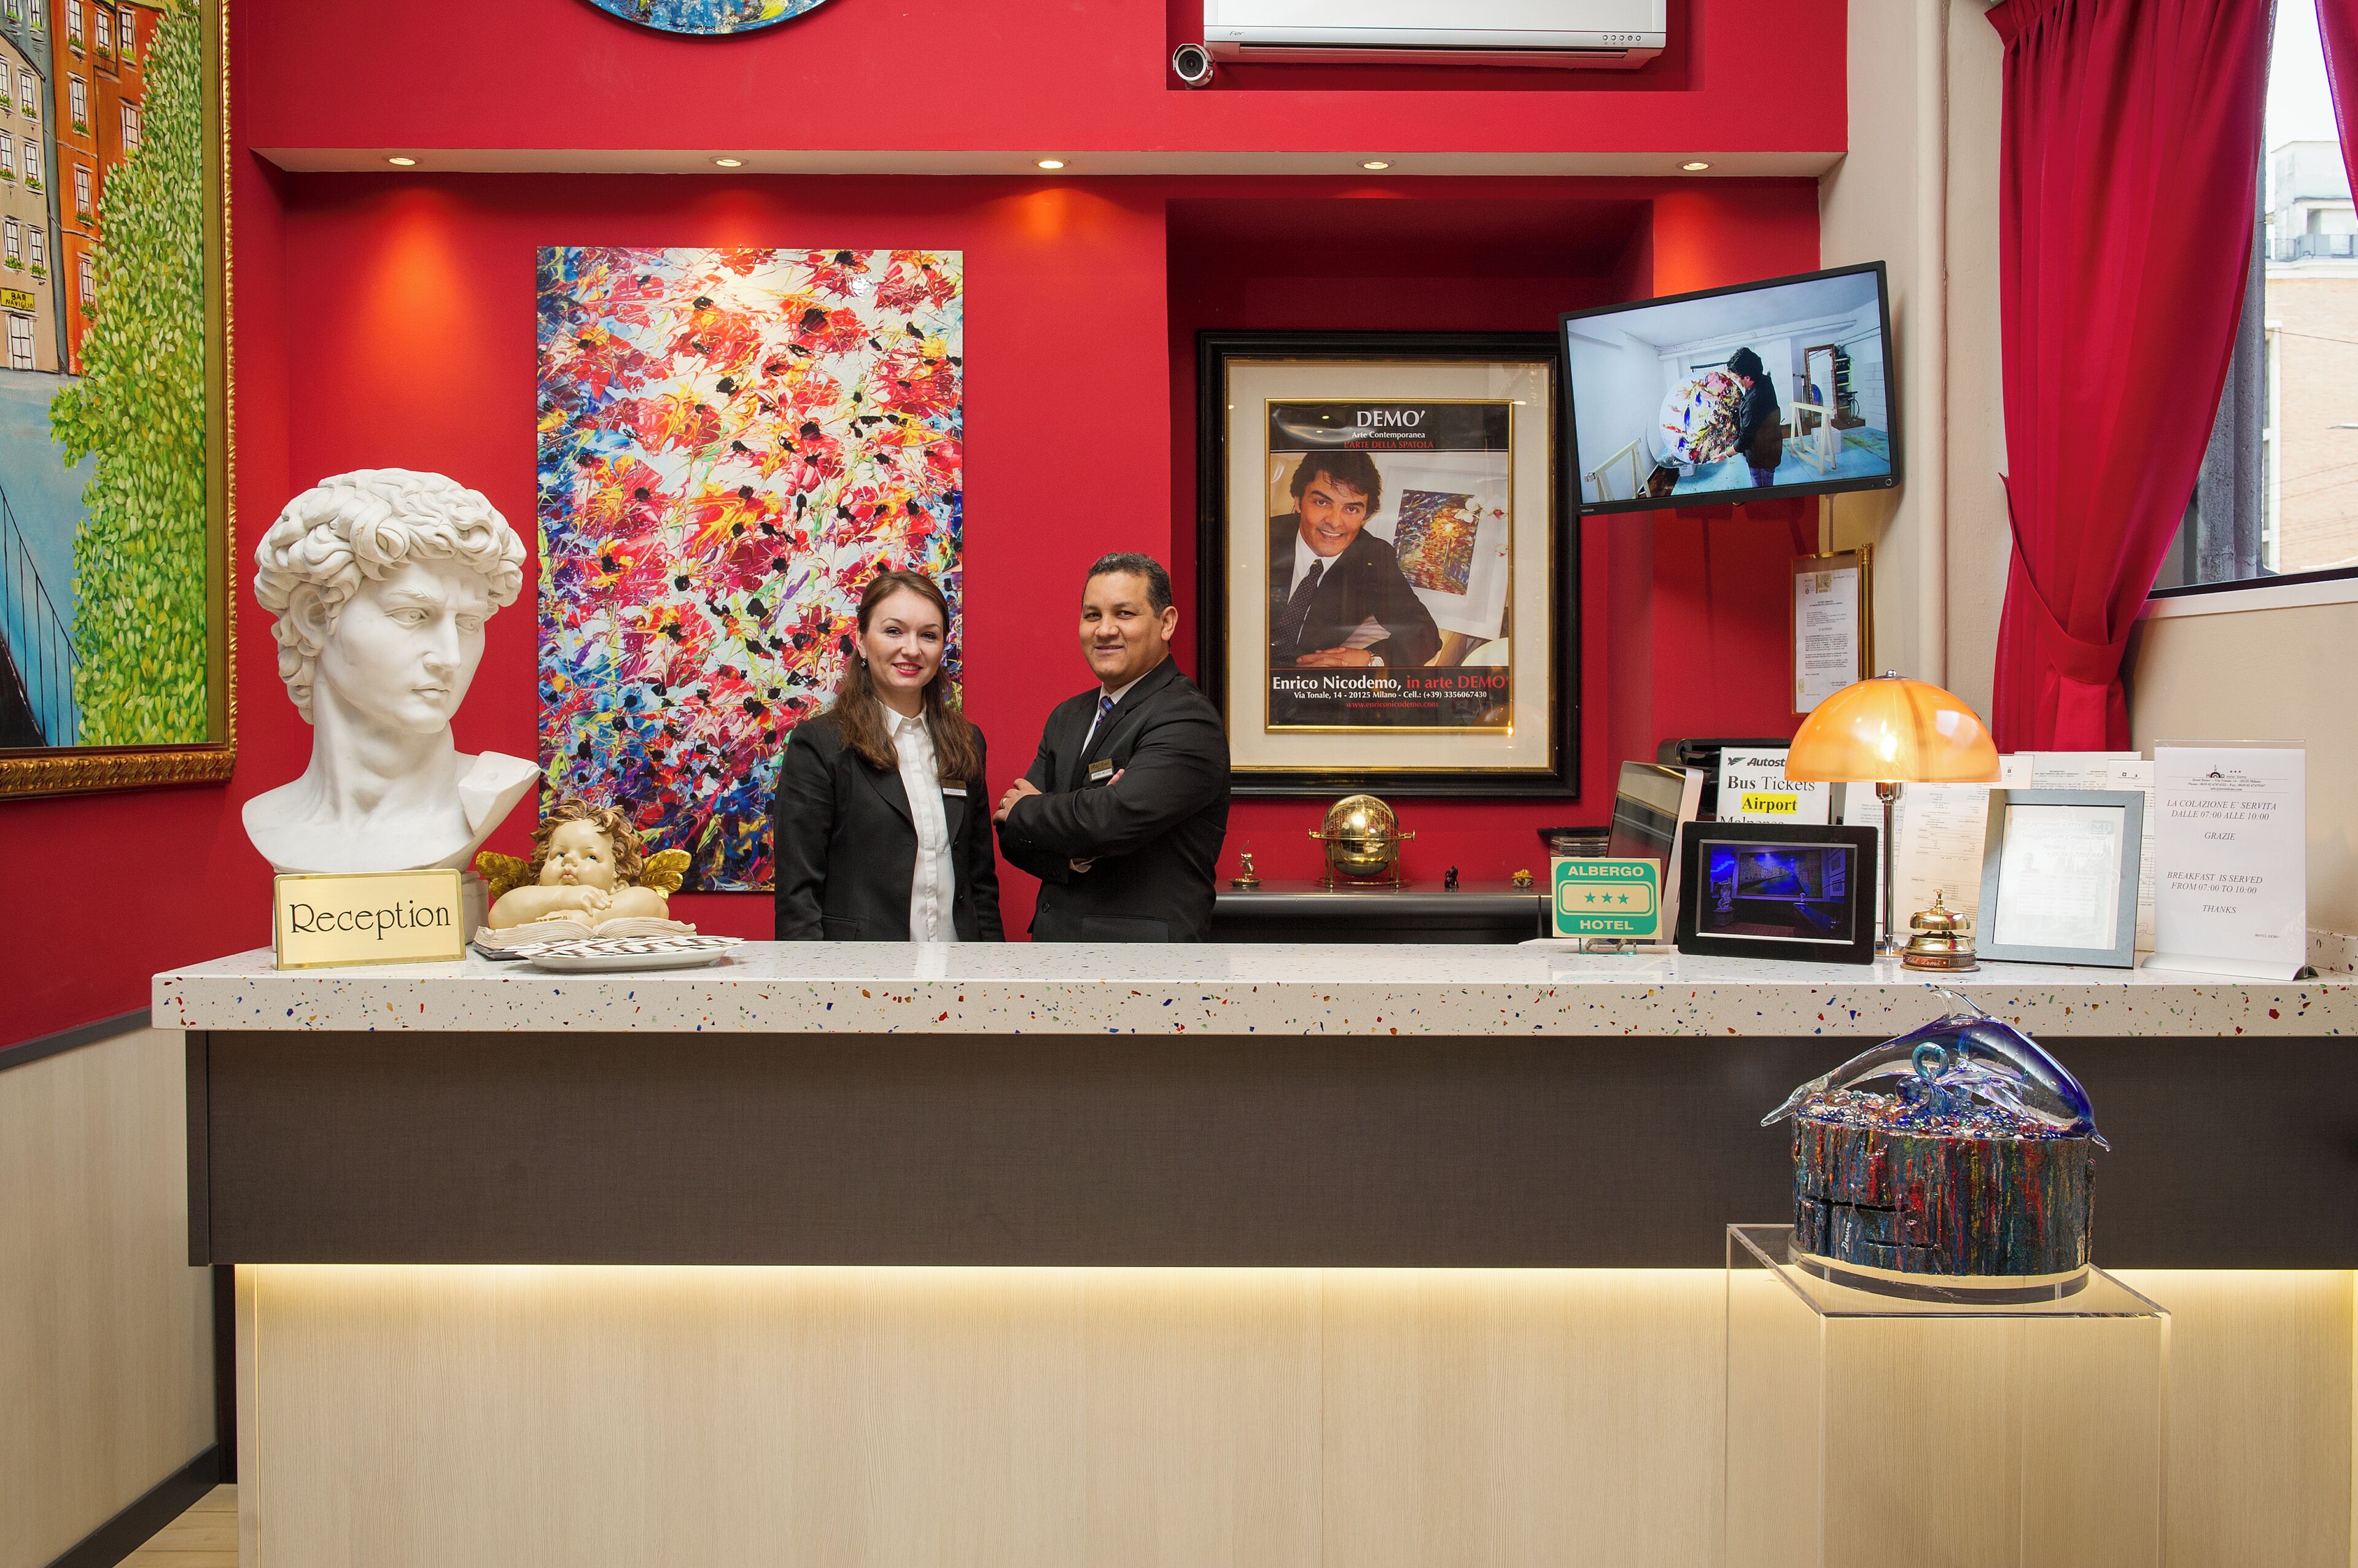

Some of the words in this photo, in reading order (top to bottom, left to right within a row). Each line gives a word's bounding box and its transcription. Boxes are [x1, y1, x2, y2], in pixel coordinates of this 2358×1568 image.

[11, 292, 26, 302] BAR
[6, 299, 33, 309] NAVIGLIO
[1369, 431, 1425, 440] Contemporanea
[1273, 675, 1318, 689] Enrico
[1323, 675, 1401, 691] Nicodemo,
[1406, 675, 1420, 688] in
[1425, 677, 1453, 689] arte
[1423, 691, 1442, 699] (+39)
[1727, 775, 1756, 790] Bus
[1761, 776, 1815, 791] Tickets
[1741, 797, 1797, 813] Airport
[2179, 799, 2228, 809] COLAZIONE
[2241, 802, 2276, 810] SERVITA
[2204, 832, 2236, 840] GRAZIE
[1568, 866, 1644, 877] ALBERGO
[2167, 871, 2215, 881] BREAKFAST
[2228, 875, 2263, 884] SERVED
[2171, 882, 2197, 891] FROM
[2235, 885, 2257, 894] 10:00
[2203, 905, 2237, 914] THANKS
[289, 900, 451, 941] Reception
[1580, 920, 1634, 930] HOTEL
